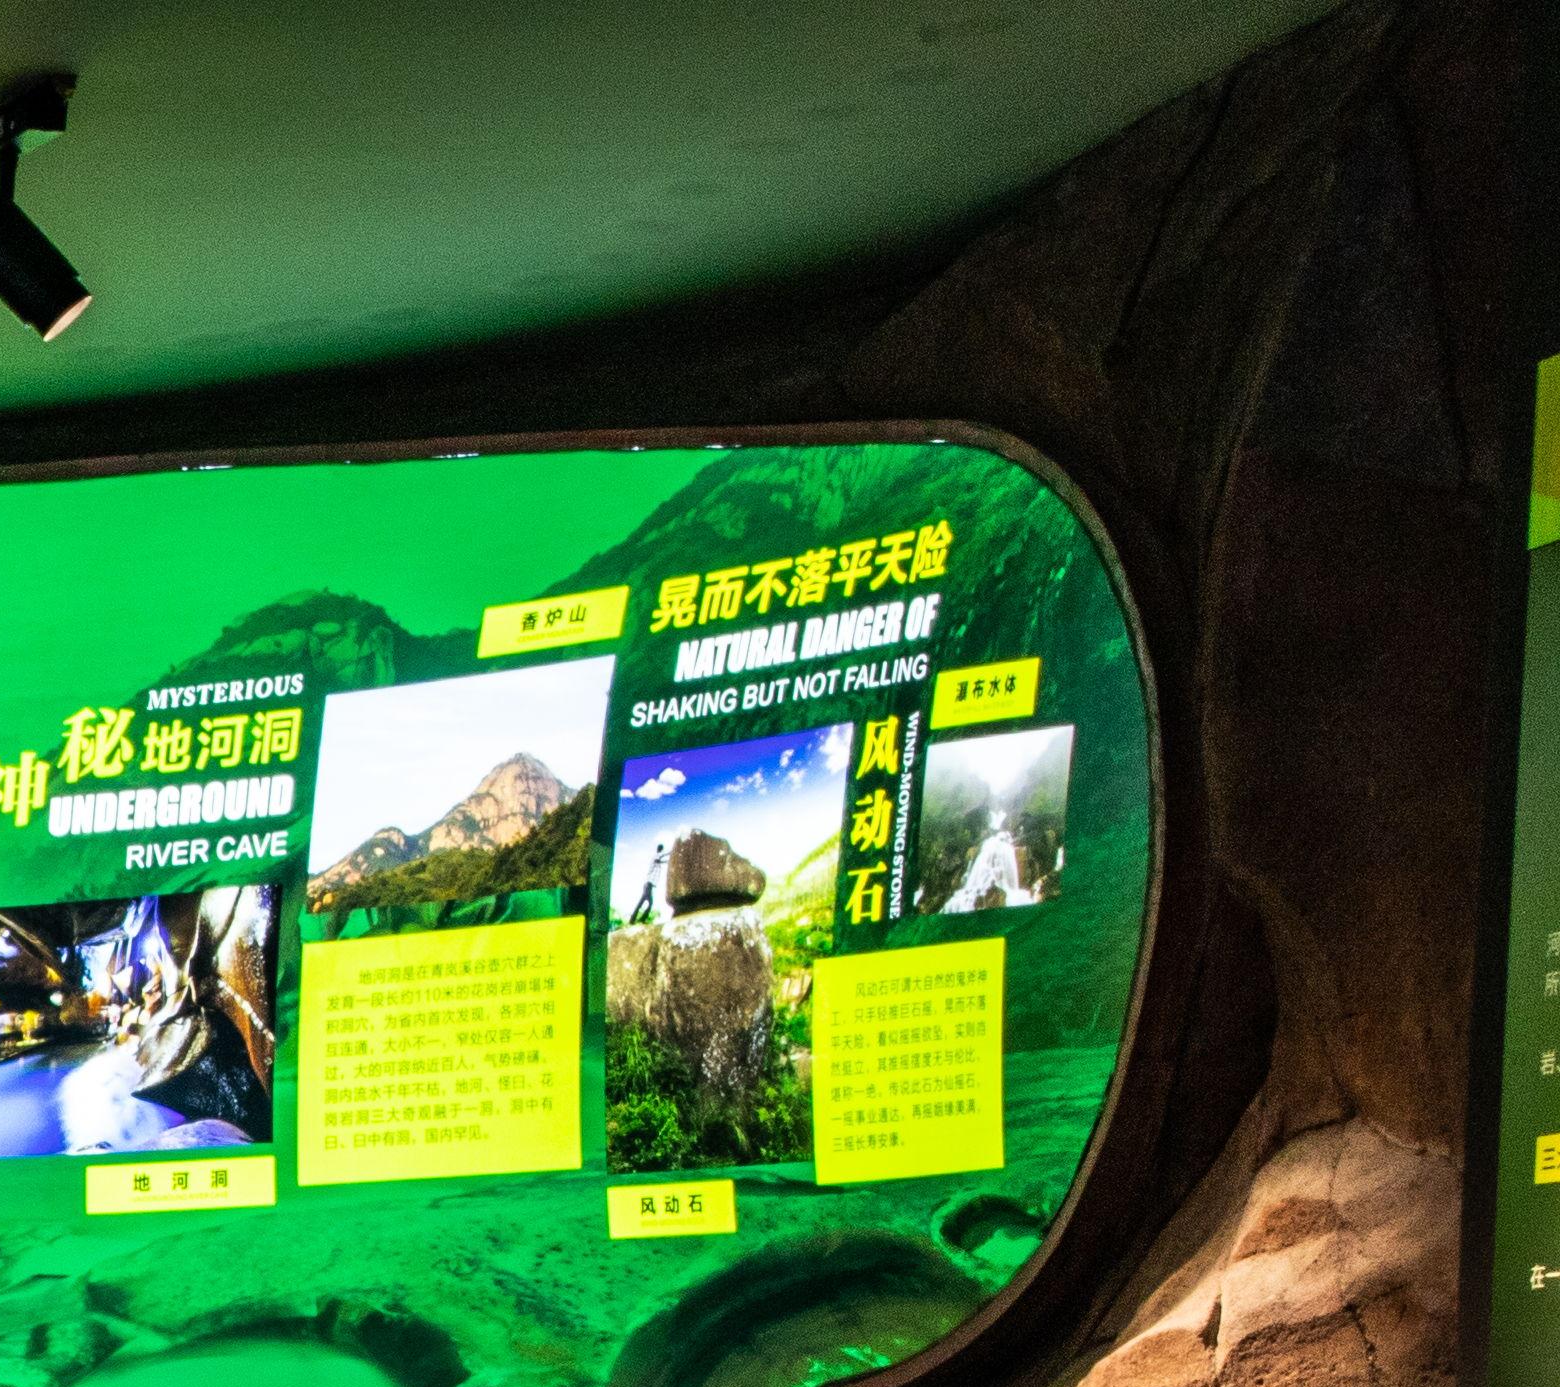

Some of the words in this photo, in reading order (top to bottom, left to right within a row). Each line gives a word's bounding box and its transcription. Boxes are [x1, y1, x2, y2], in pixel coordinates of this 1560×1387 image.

[650, 520, 953, 632] 晃而不落平天险
[522, 605, 586, 632] 香炉山
[674, 620, 798, 682] NATURAL
[802, 602, 903, 663] DANGER
[906, 594, 941, 642] OF
[146, 674, 304, 712] MYSTERIOUS
[630, 686, 739, 728] SHAKING
[742, 677, 786, 709] BUT
[789, 668, 840, 701] NOT
[842, 654, 930, 694] FALLING
[955, 675, 1016, 702] 瀑布水体
[48, 776, 294, 838] UNDERGROUND
[844, 713, 903, 925] 风动石
[125, 837, 209, 871] RIVER
[217, 830, 289, 861] CAVE
[889, 853, 906, 922] STONE
[133, 1169, 229, 1192] 地河洞
[641, 1194, 703, 1215] 风动石
